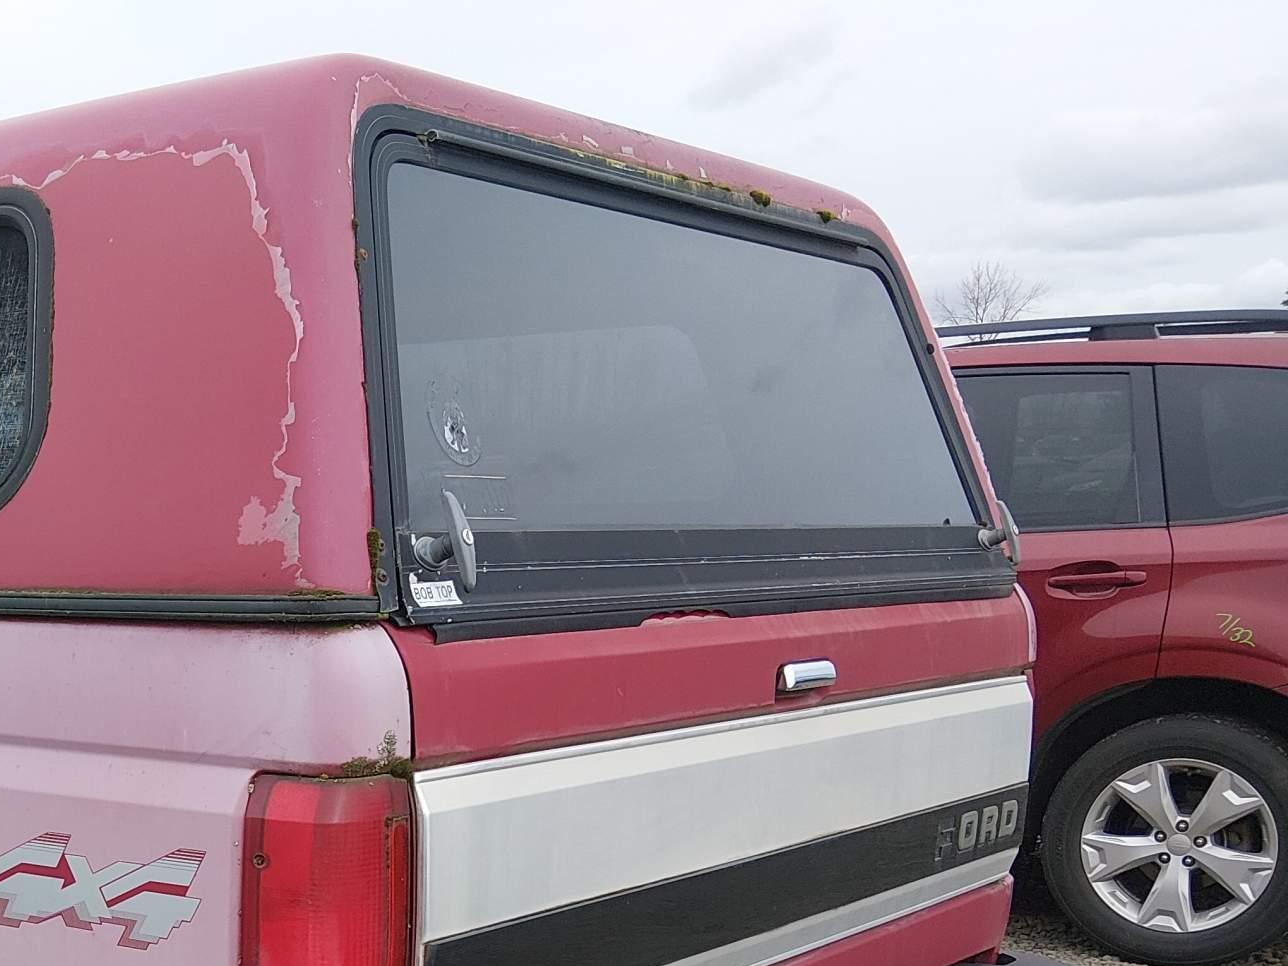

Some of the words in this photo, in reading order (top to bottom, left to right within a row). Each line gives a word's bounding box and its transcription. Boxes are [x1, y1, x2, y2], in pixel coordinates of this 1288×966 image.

[414, 587, 434, 600] BOB
[436, 585, 453, 599] TOP
[1215, 613, 1256, 647] 7/32
